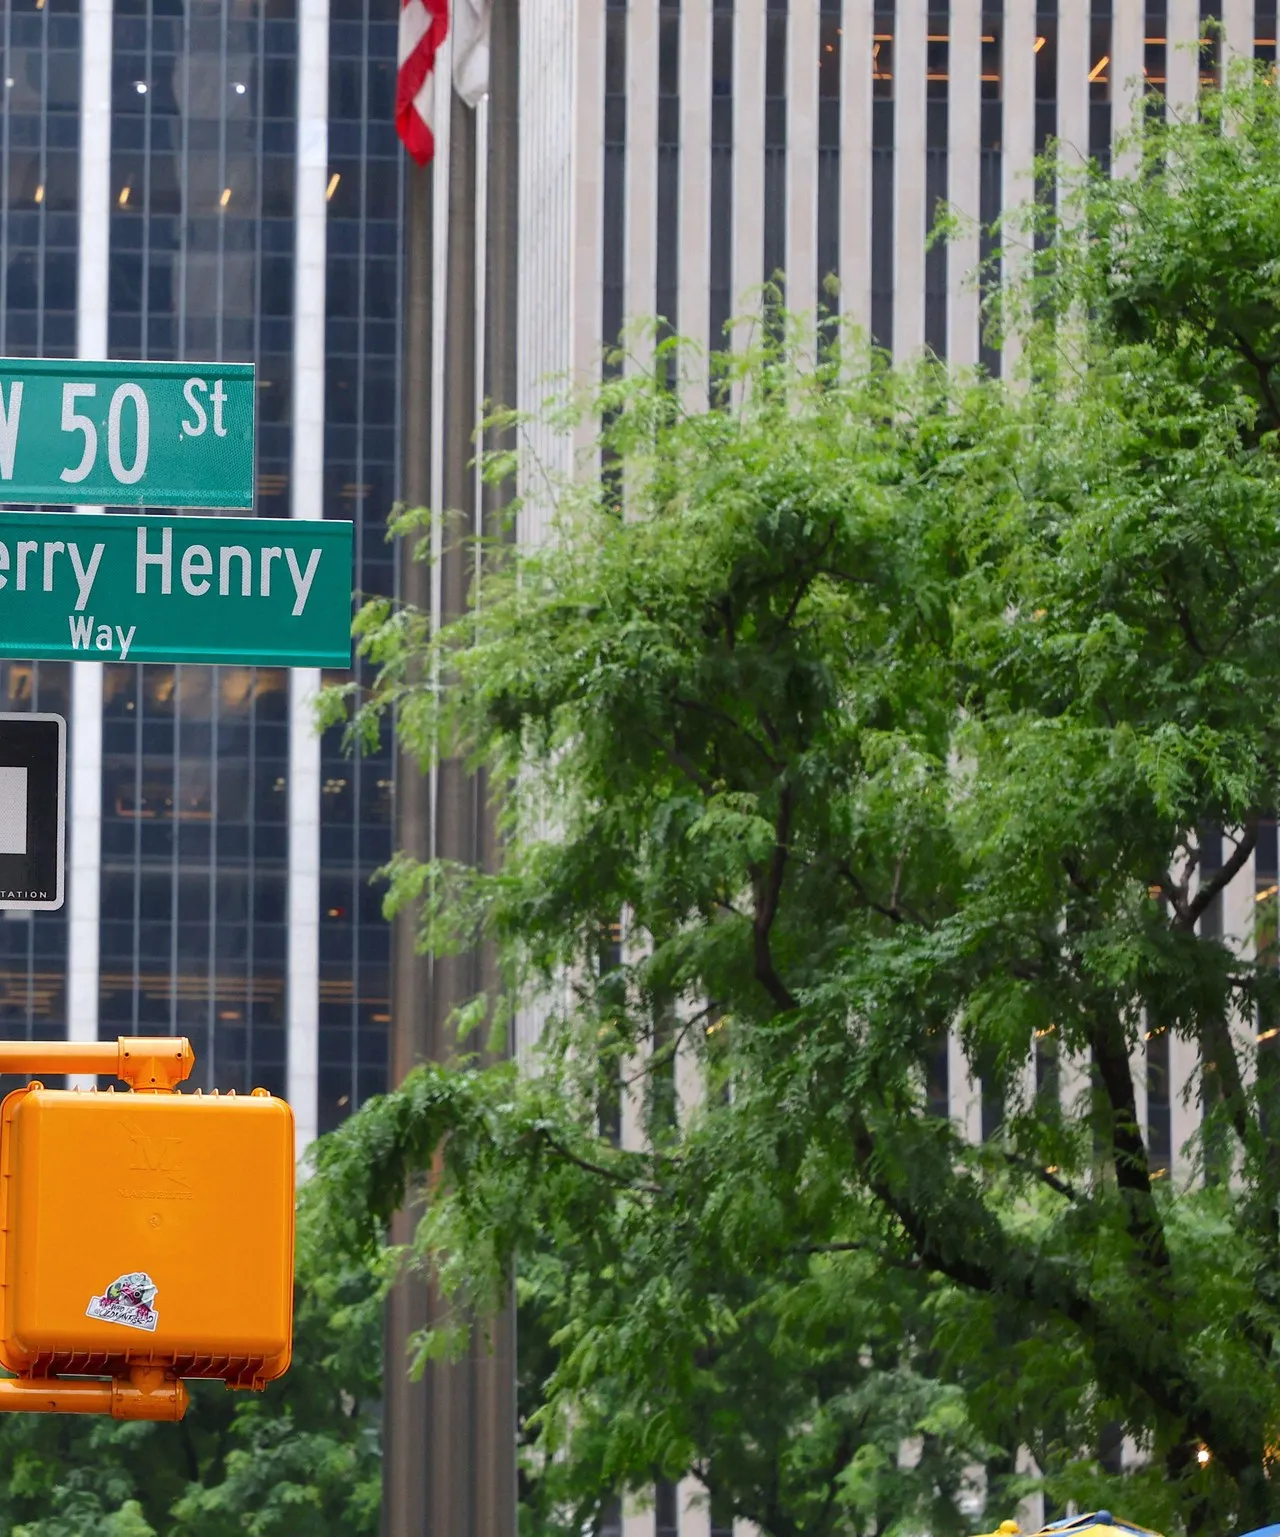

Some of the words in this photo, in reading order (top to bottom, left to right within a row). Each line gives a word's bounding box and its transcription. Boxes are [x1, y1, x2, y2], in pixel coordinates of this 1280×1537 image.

[60, 382, 150, 484] 50
[181, 376, 228, 437] St
[135, 525, 323, 616] Henry
[69, 615, 136, 660] Way
